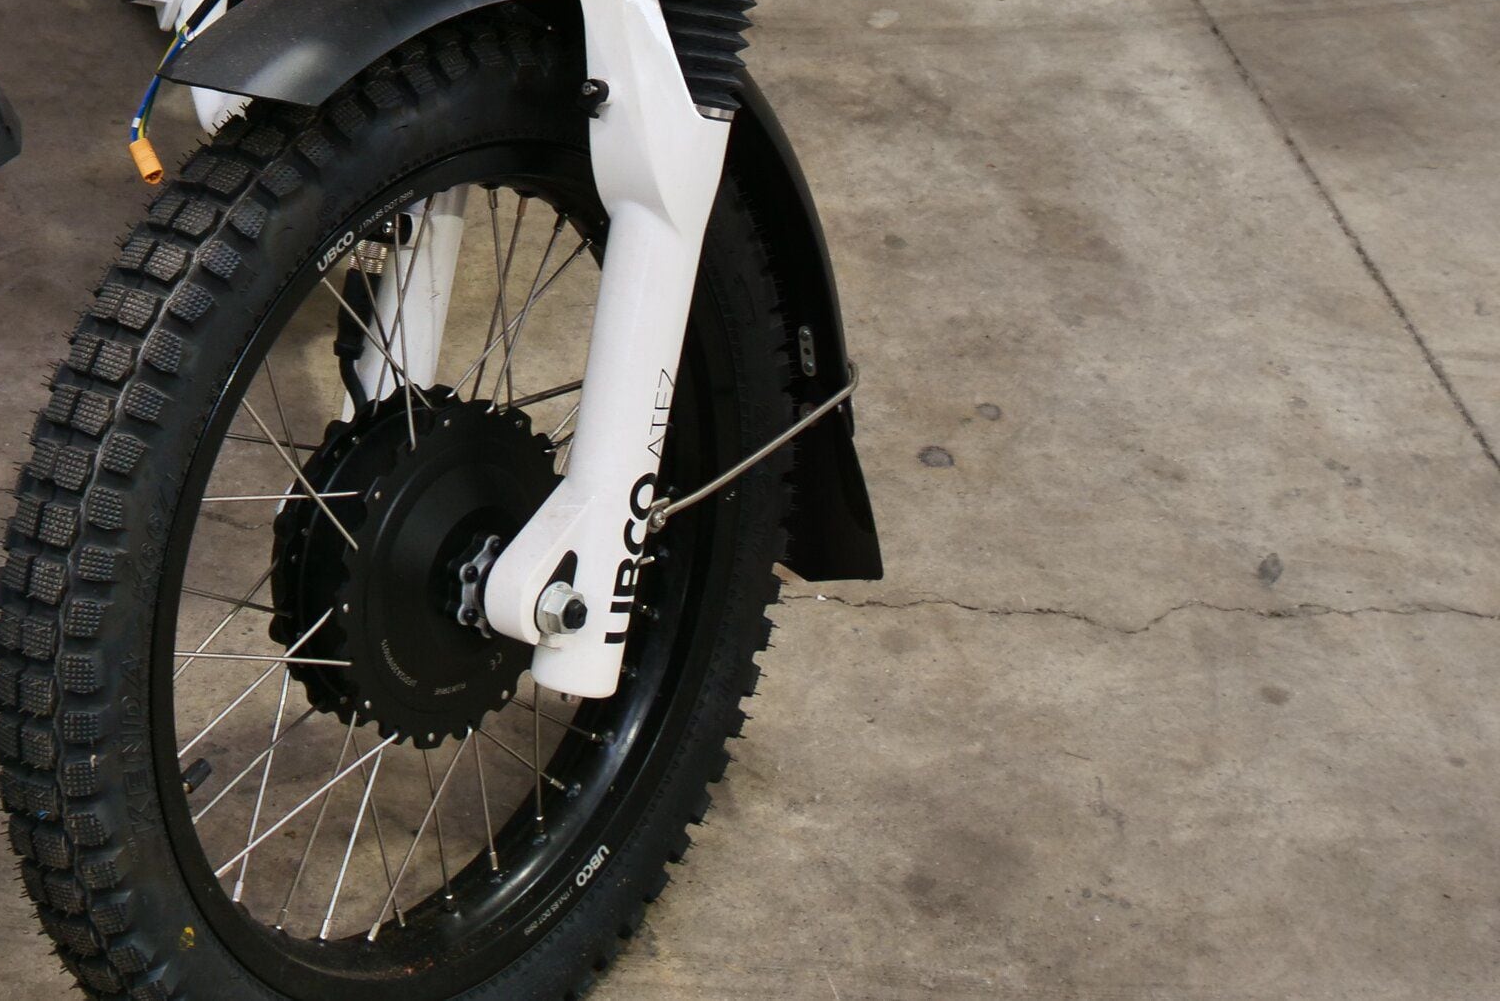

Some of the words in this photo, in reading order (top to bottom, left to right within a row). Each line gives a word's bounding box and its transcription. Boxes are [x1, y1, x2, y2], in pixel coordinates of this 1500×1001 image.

[317, 231, 354, 272] UBCO
[604, 472, 657, 644] UBCO
[576, 845, 610, 887] UBCO
